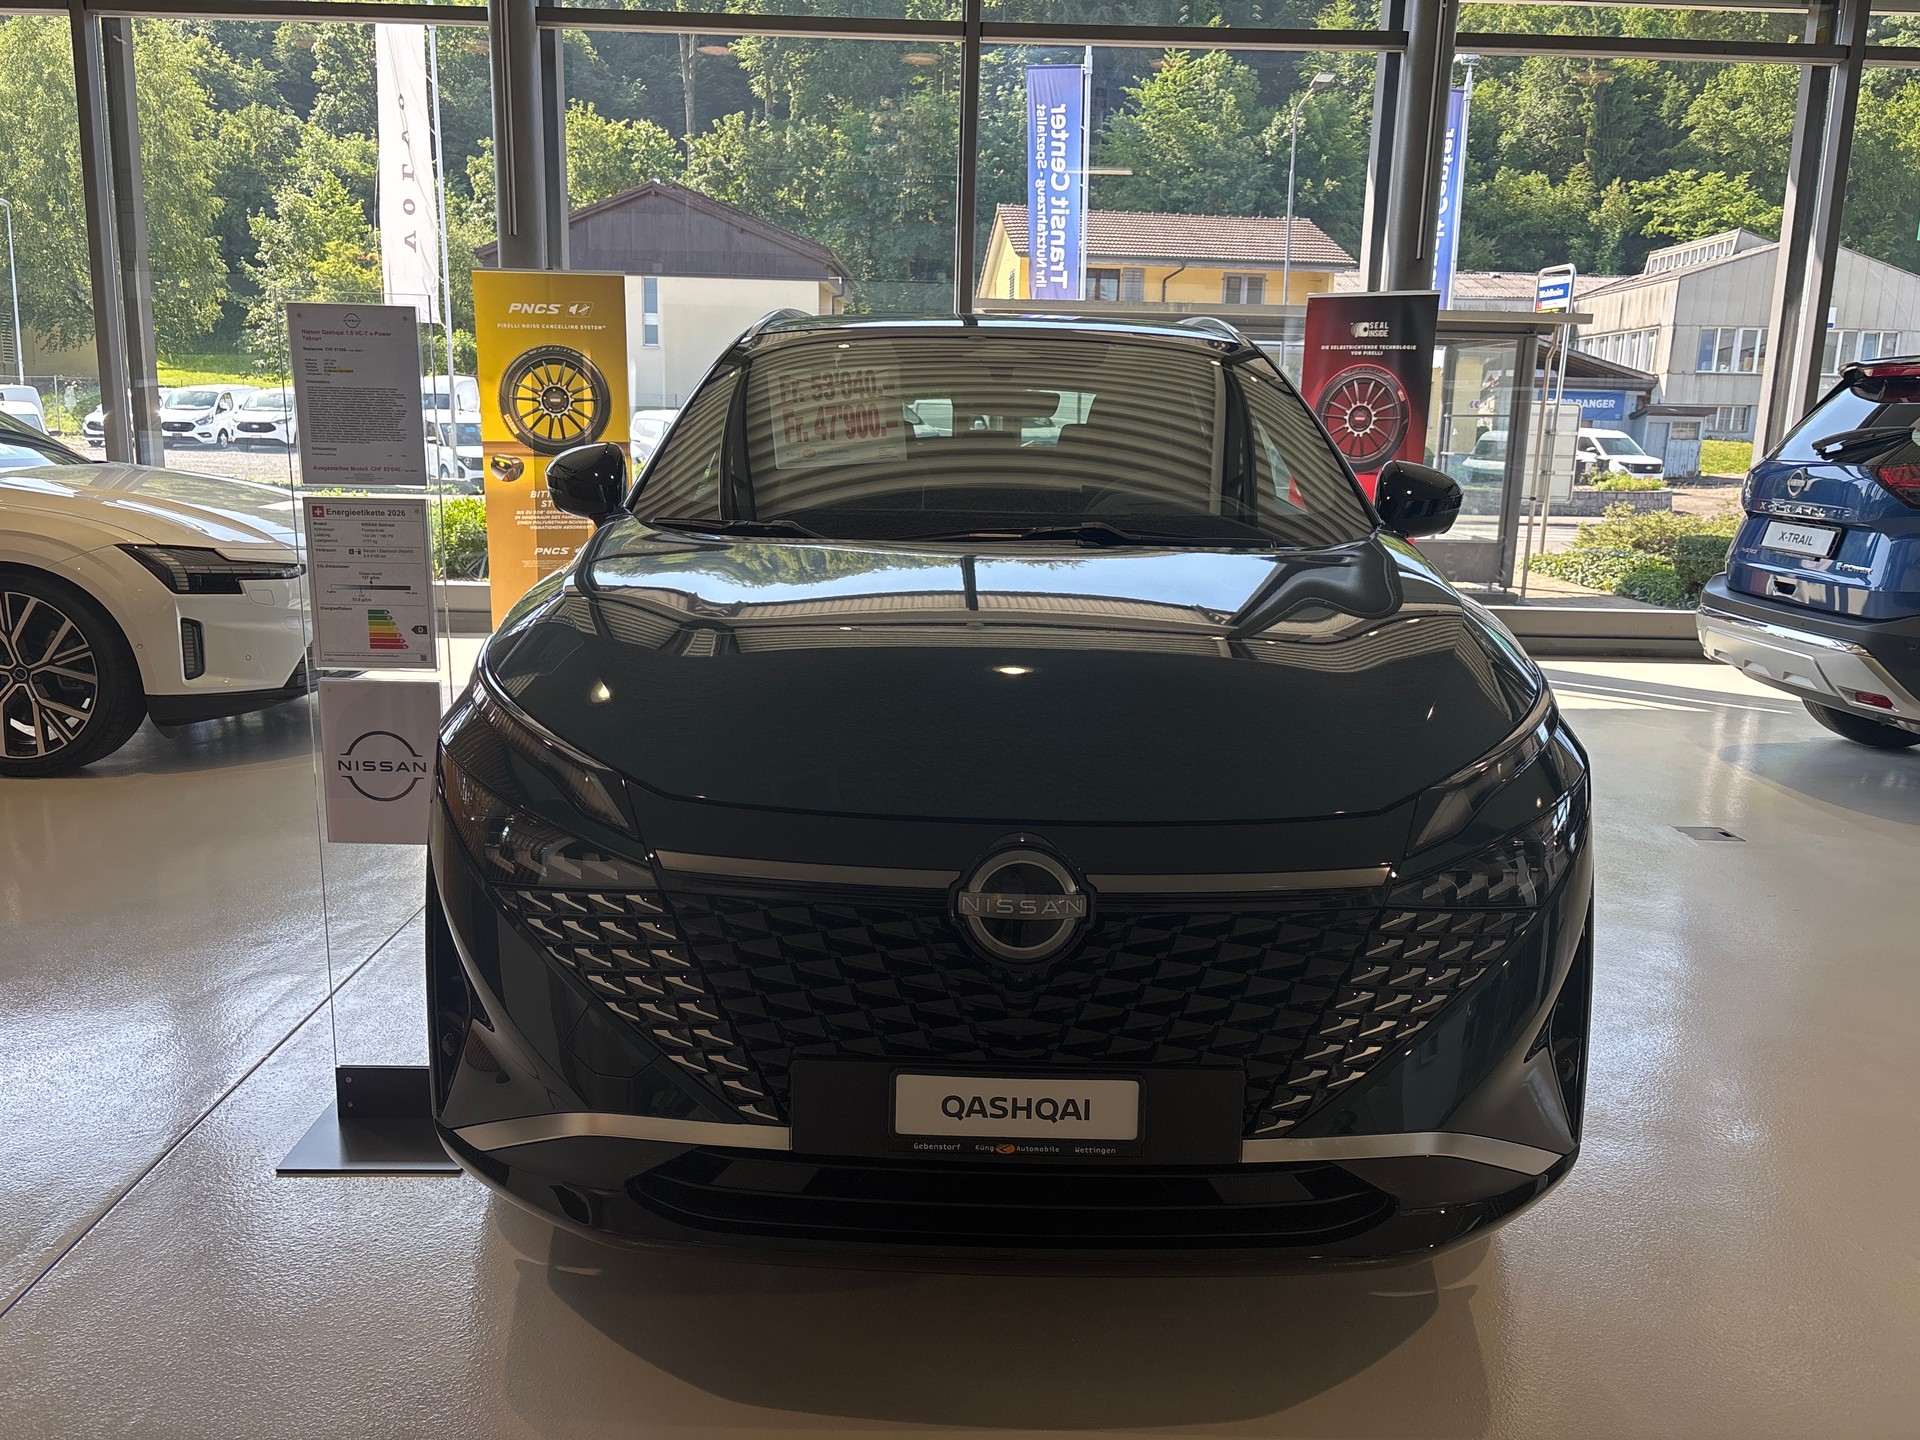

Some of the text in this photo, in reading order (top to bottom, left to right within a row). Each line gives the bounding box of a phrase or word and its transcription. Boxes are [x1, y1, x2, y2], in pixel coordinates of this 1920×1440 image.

[508, 303, 561, 314] PNCS
[783, 409, 809, 443] Fr.
[326, 508, 406, 517] Energieetikette 2026
[1778, 531, 1813, 546] X-TRAIL
[534, 547, 569, 555] PNCS
[338, 760, 427, 773] NISSAN
[962, 896, 1084, 915] NISSAN
[941, 1095, 1091, 1123] QASHQAI
[975, 1144, 994, 1152] Küng
[1075, 1146, 1116, 1154] Wettingen
